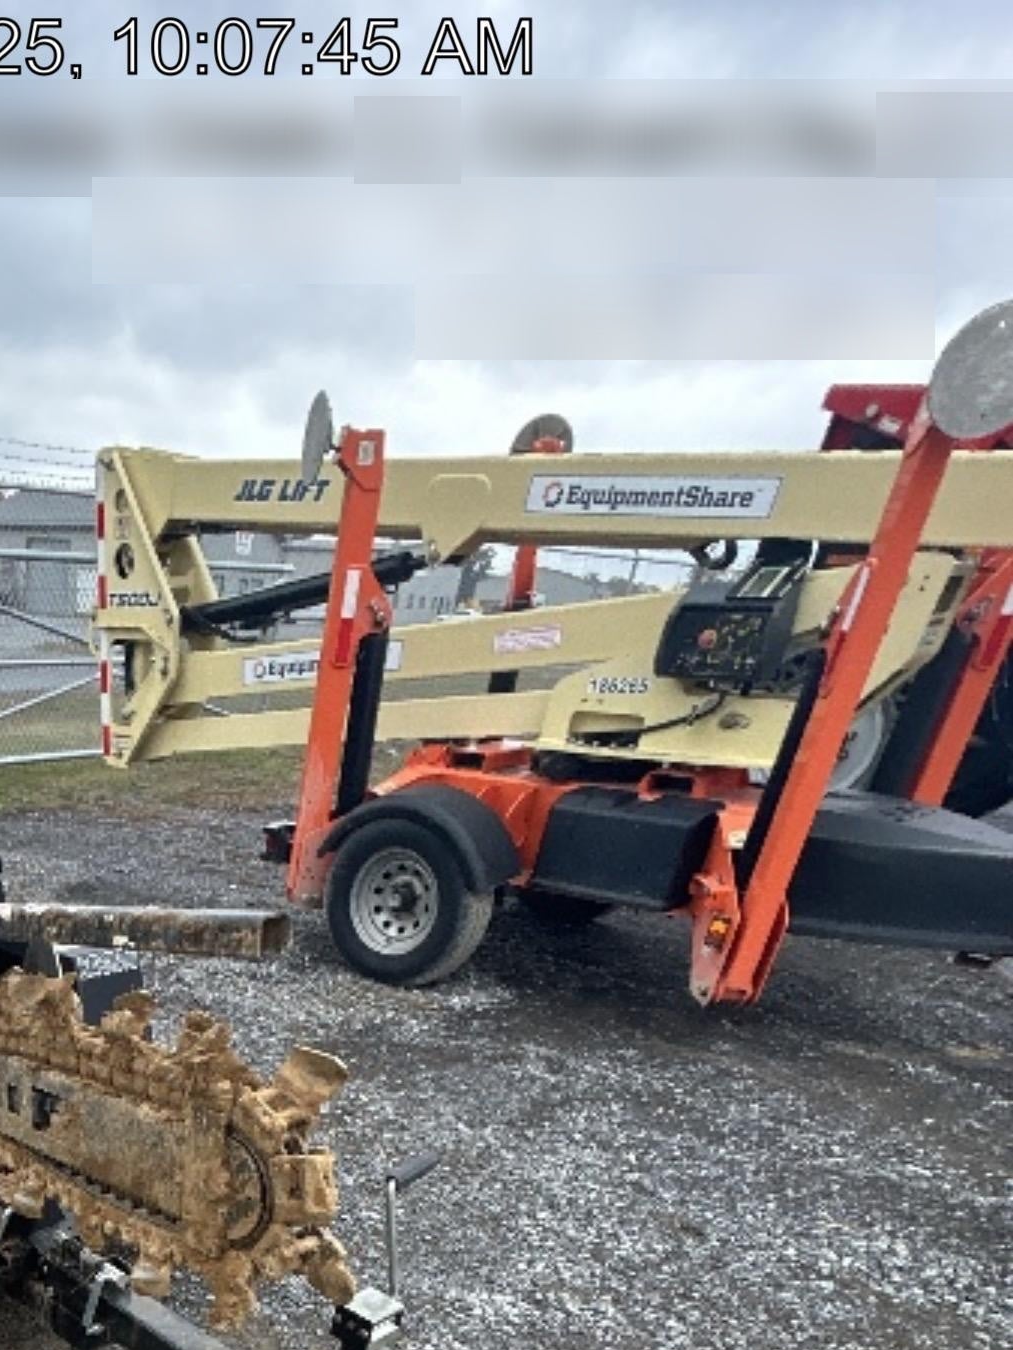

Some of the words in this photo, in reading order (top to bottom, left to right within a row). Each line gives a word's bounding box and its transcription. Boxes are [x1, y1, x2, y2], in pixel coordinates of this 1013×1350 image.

[234, 479, 276, 502] JLG
[277, 479, 330, 502] LIFT
[566, 485, 754, 510] EquipmentShare
